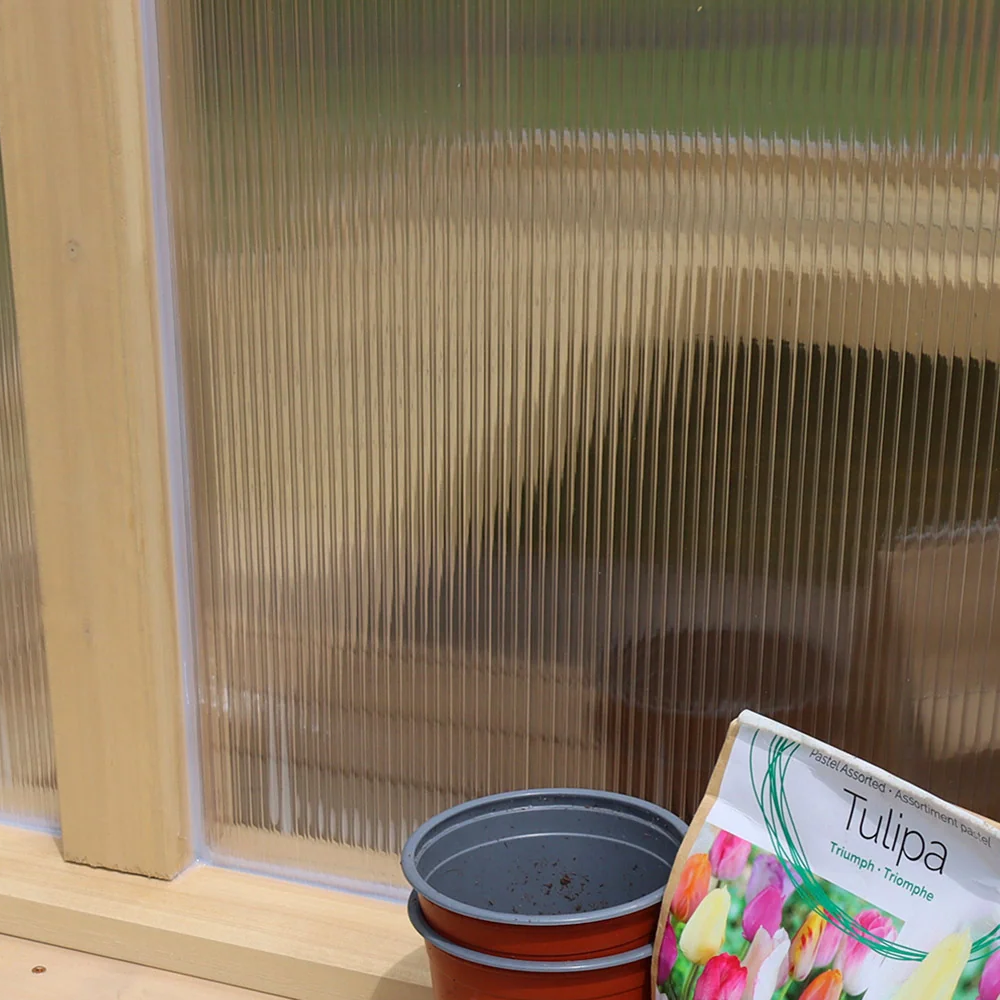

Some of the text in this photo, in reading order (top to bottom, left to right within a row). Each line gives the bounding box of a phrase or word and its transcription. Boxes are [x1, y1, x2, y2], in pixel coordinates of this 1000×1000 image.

[809, 748, 992, 848] Pastel Assorted Assortiment pastel
[843, 788, 948, 875] Tulipa
[830, 841, 935, 902] Triumph Triomphe
